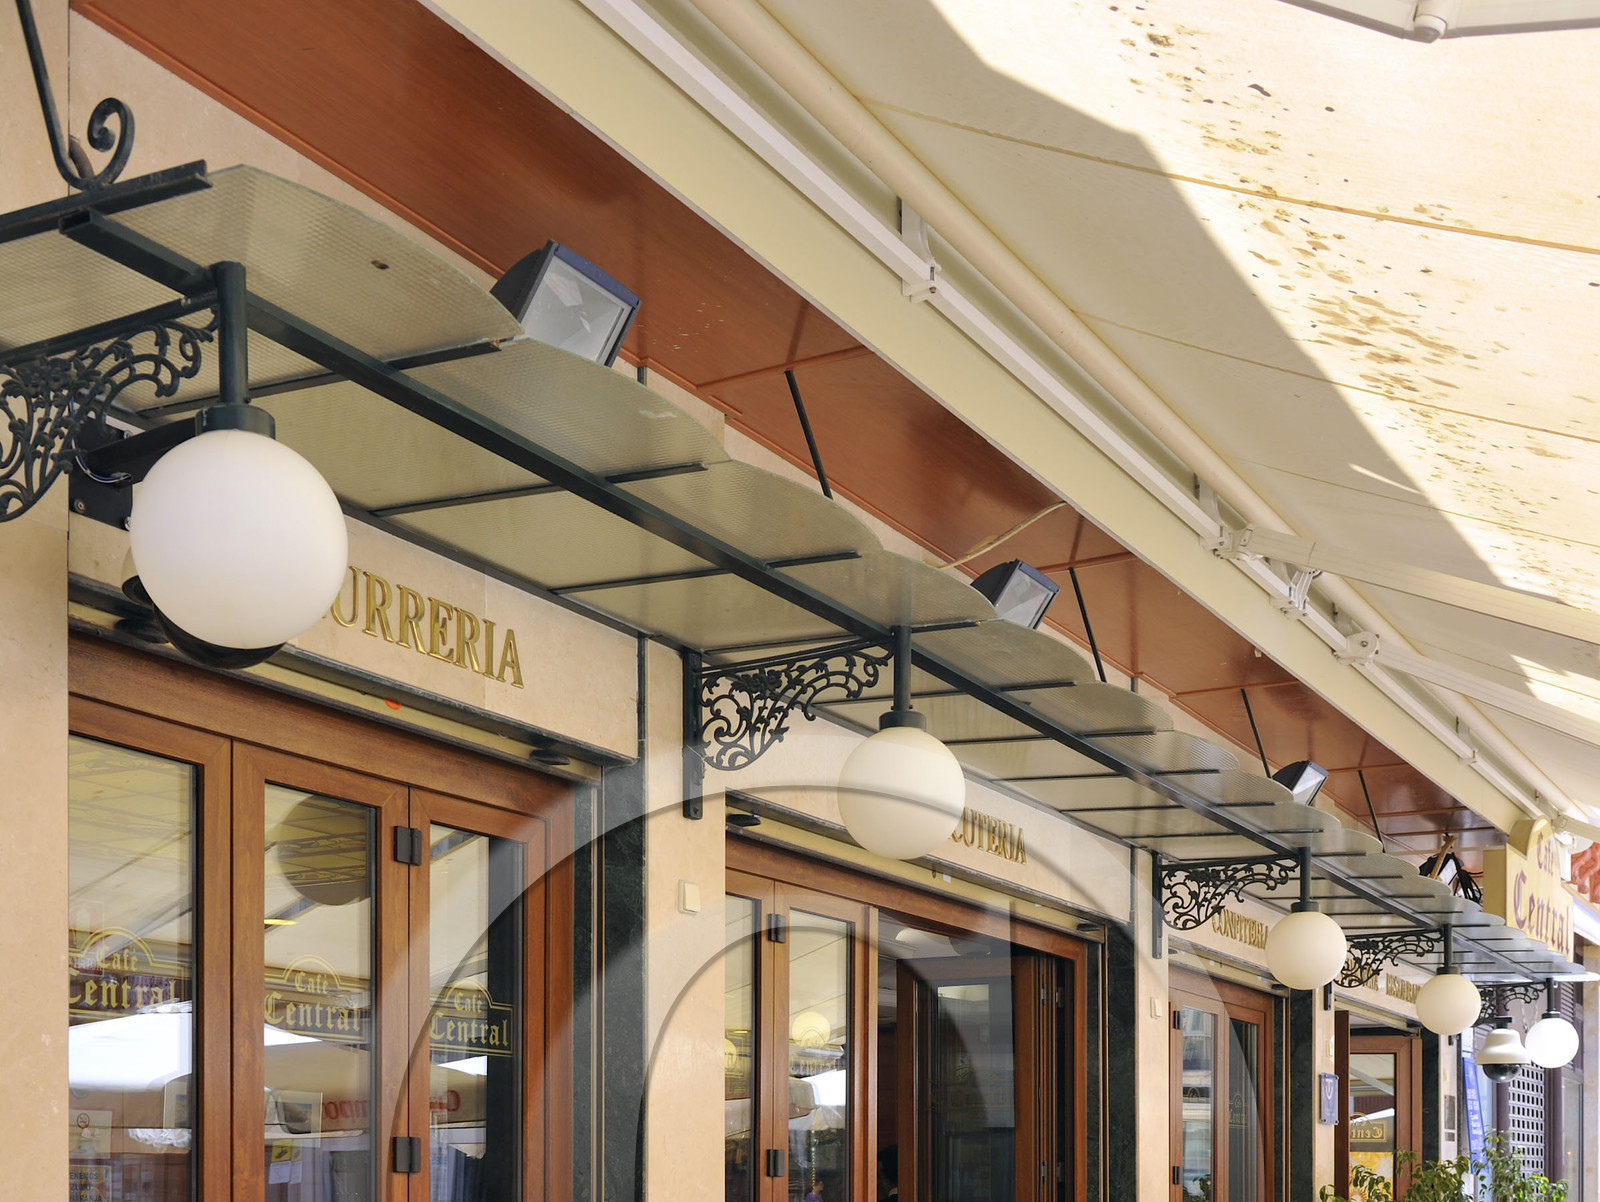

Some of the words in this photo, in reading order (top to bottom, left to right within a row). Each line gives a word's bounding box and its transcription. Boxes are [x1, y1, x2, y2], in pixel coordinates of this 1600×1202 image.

[1513, 869, 1571, 956] Central
[97, 944, 138, 972] Café
[294, 971, 329, 995] Café
[264, 990, 361, 1032] Central
[453, 991, 483, 1014] Café
[430, 1010, 510, 1048] Central
